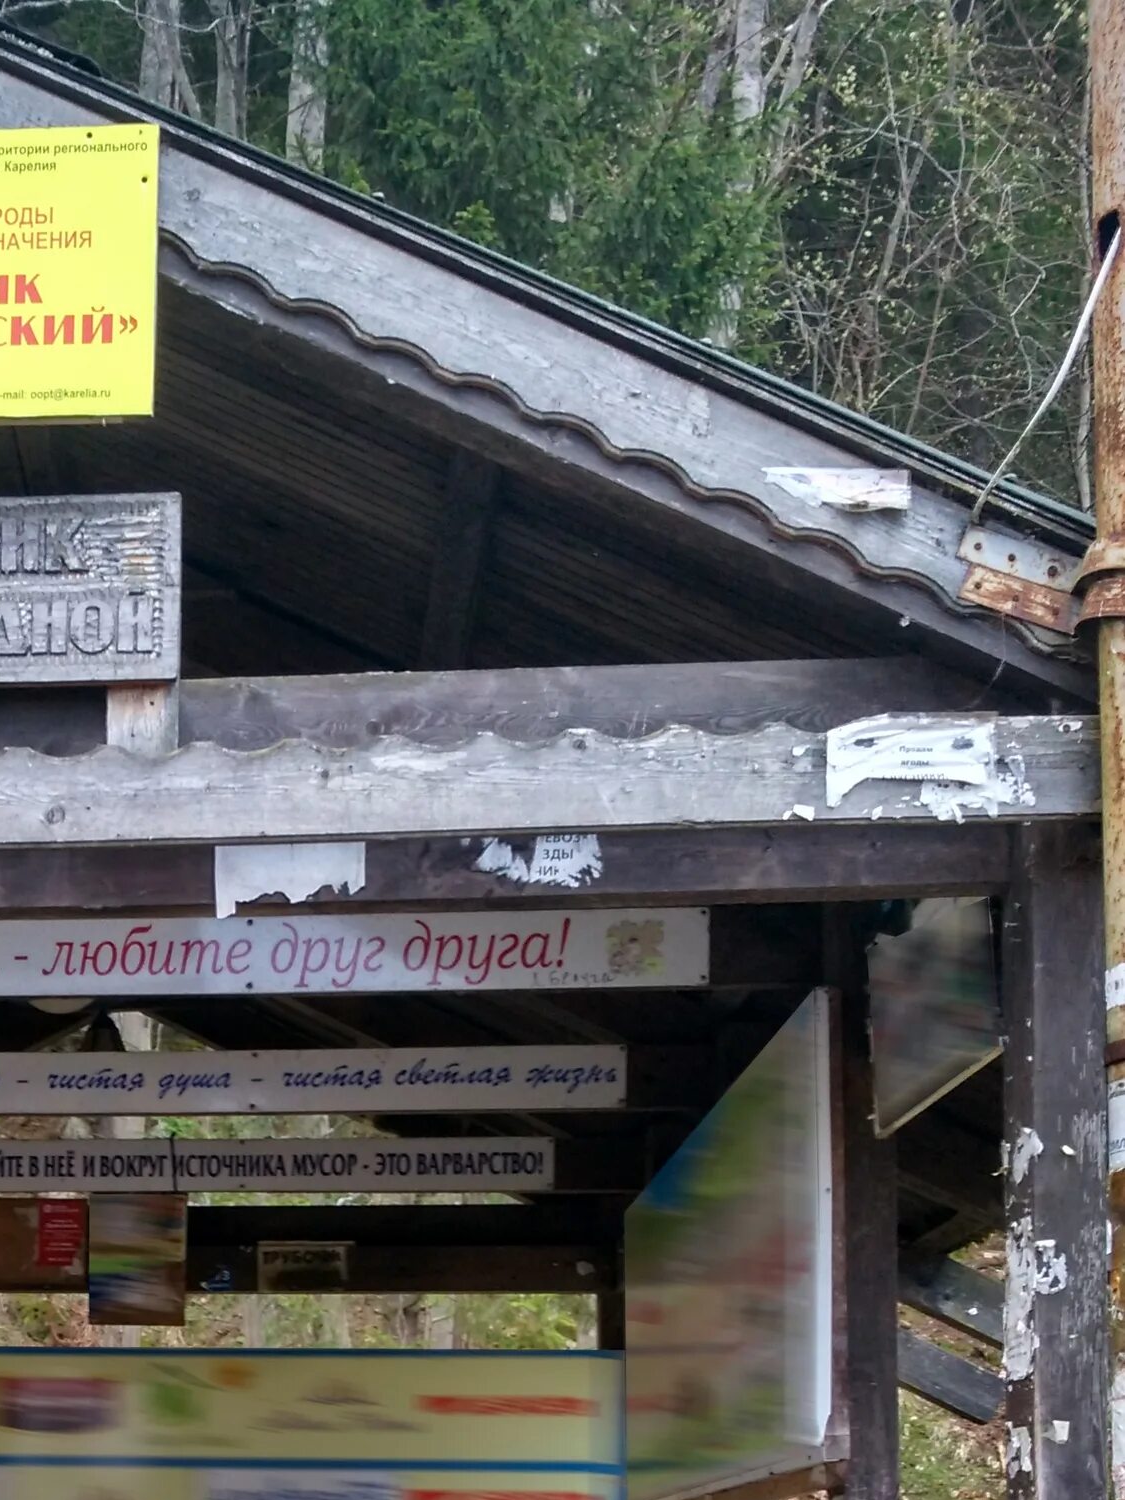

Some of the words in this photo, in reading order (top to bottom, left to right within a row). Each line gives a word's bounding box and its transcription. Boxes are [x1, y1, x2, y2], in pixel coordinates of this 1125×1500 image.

[53, 141, 148, 156] регионального
[4, 160, 57, 174] Карелия
[30, 388, 111, 402] oopt@karelia.ru
[545, 833, 587, 843] ЕВОЗ
[41, 926, 252, 978] любите
[270, 920, 386, 988] друг
[402, 917, 572, 986] друга!
[47, 1067, 145, 1091] чистая
[158, 1071, 231, 1101] душа
[282, 1064, 383, 1090] чистая
[393, 1058, 511, 1087] светлая
[525, 1062, 618, 1094] жизнь
[29, 1155, 40, 1178] В
[44, 1149, 75, 1178] НЕЁ
[83, 1155, 96, 1178] И
[99, 1154, 165, 1178] ВОКРУГ
[174, 1152, 286, 1178] ИСТОЧНИКА
[291, 1152, 358, 1177] МУСОР
[375, 1152, 411, 1176] ЭТО
[416, 1150, 543, 1176] ВАРВАРСТВО!
